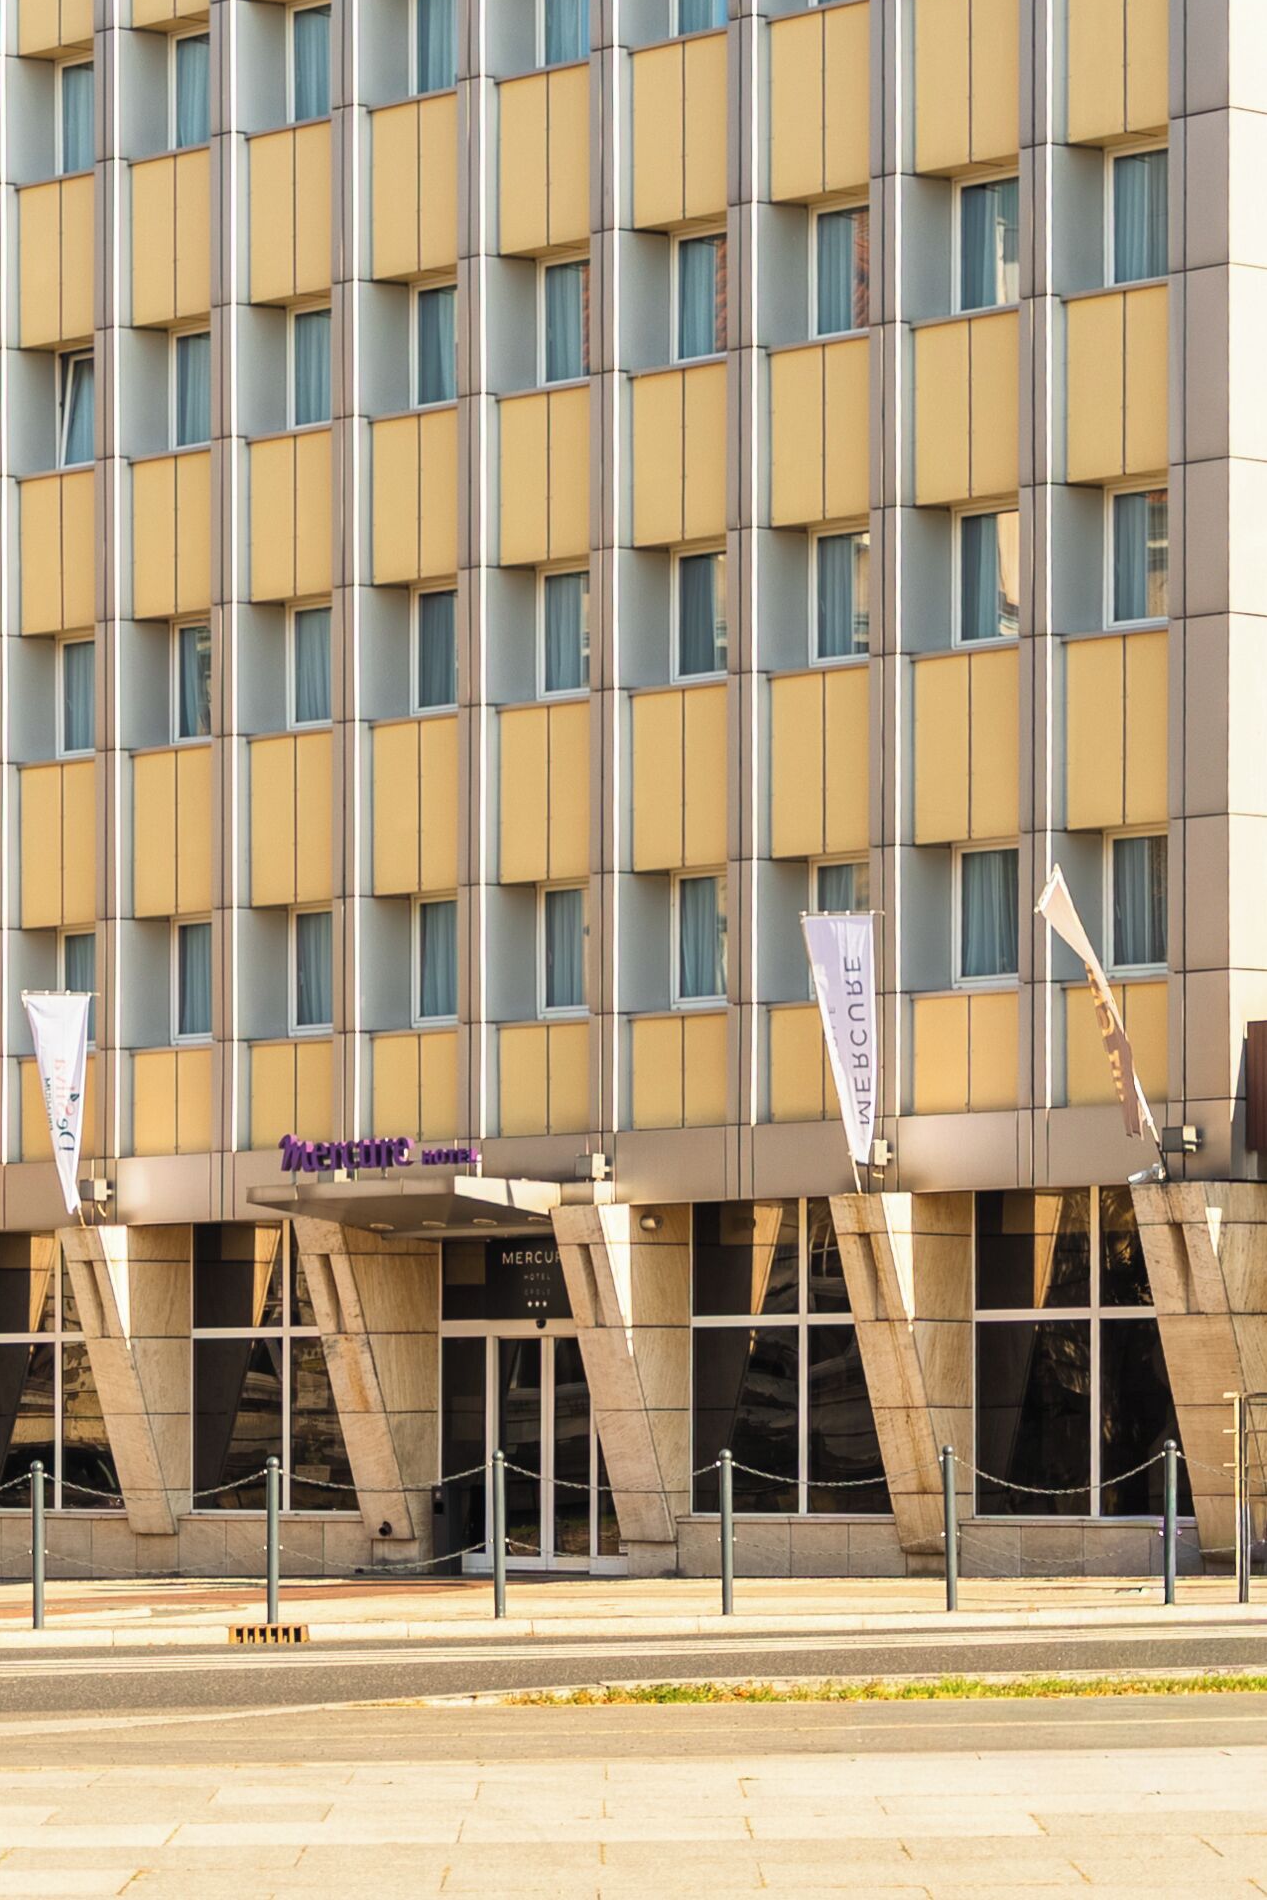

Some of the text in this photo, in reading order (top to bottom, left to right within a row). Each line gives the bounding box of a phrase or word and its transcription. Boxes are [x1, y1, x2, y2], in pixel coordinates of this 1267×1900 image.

[278, 1134, 478, 1172] Mercure HOTEL
[502, 1251, 561, 1265] MERCUR
